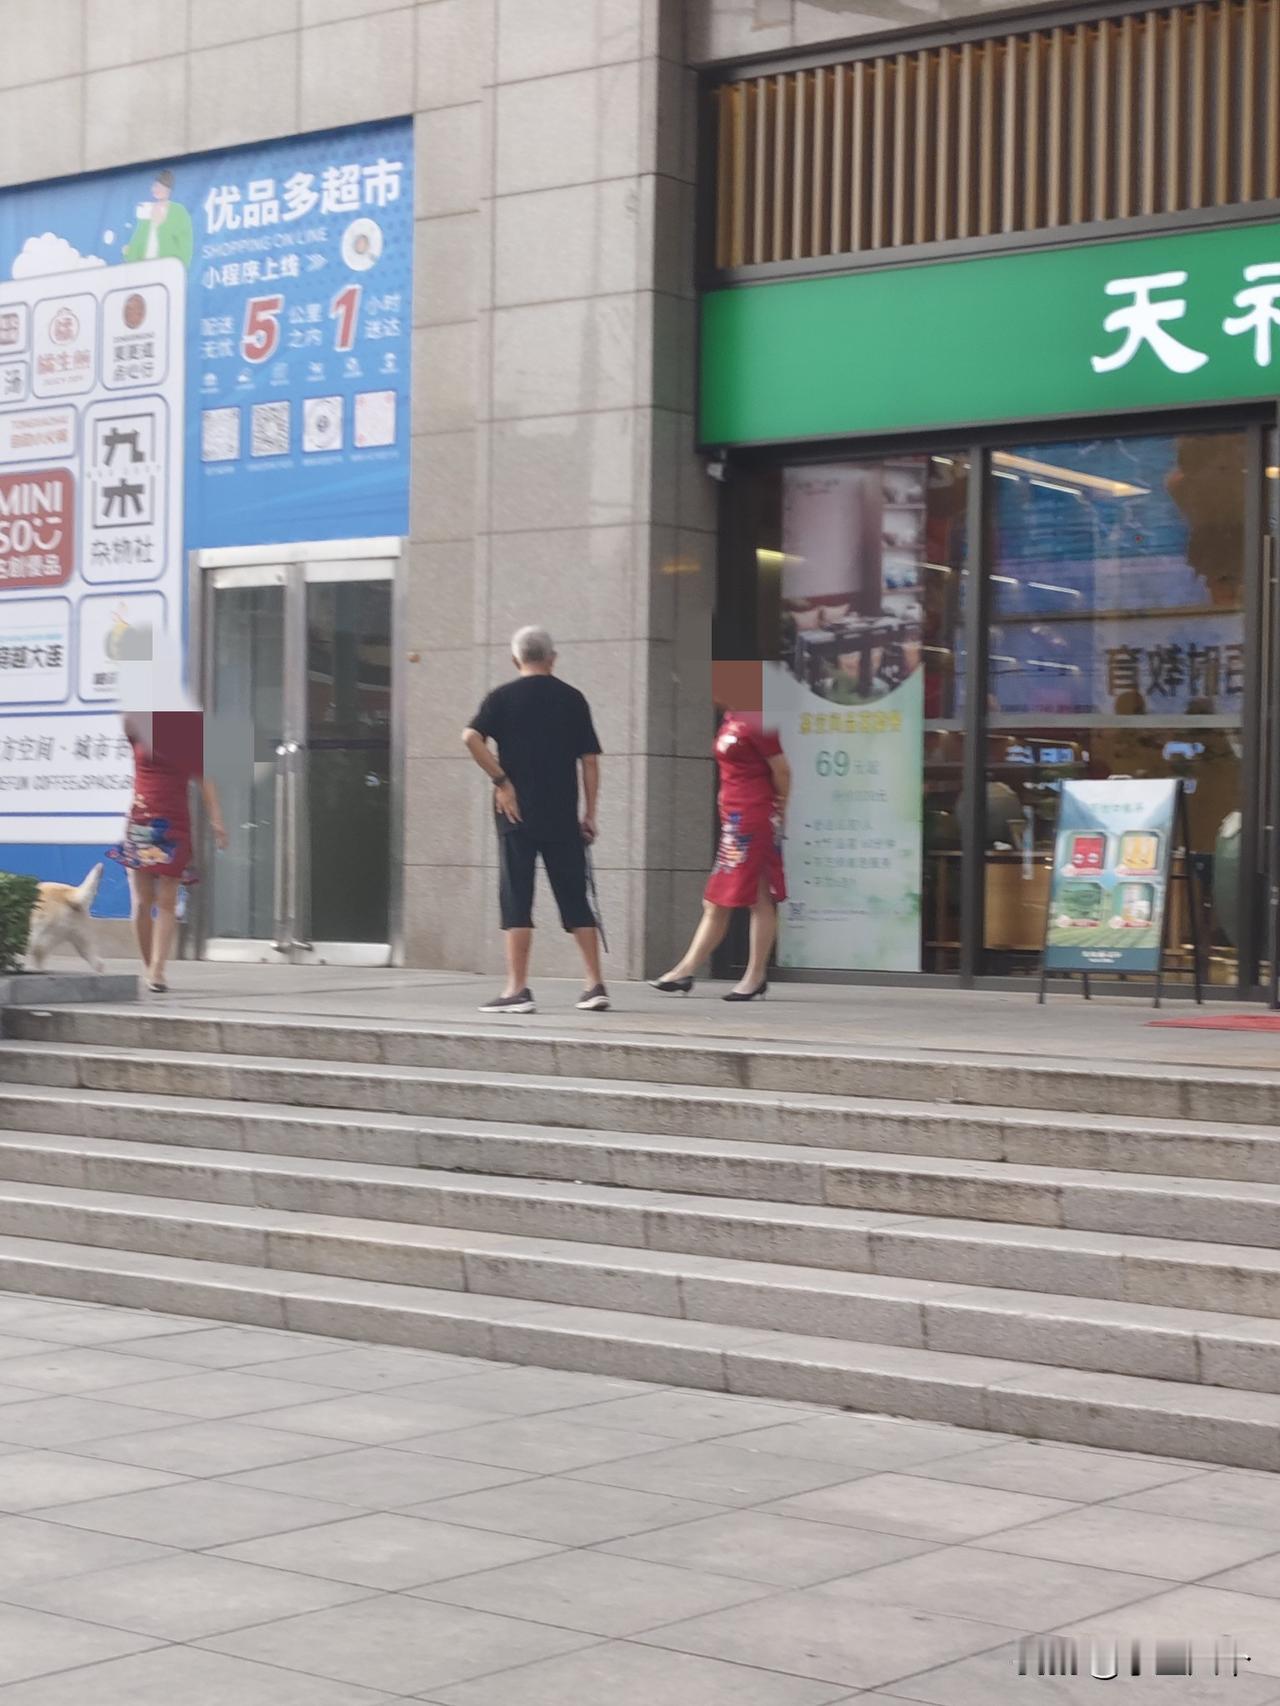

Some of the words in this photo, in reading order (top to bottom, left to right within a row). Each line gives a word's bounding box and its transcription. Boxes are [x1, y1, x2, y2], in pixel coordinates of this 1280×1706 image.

[203, 158, 404, 234] 优品多超市
[202, 253, 299, 289] 小程序上线
[240, 293, 285, 364] 5
[288, 303, 323, 324] 公里
[329, 283, 363, 352] 1
[815, 749, 850, 777] 69
